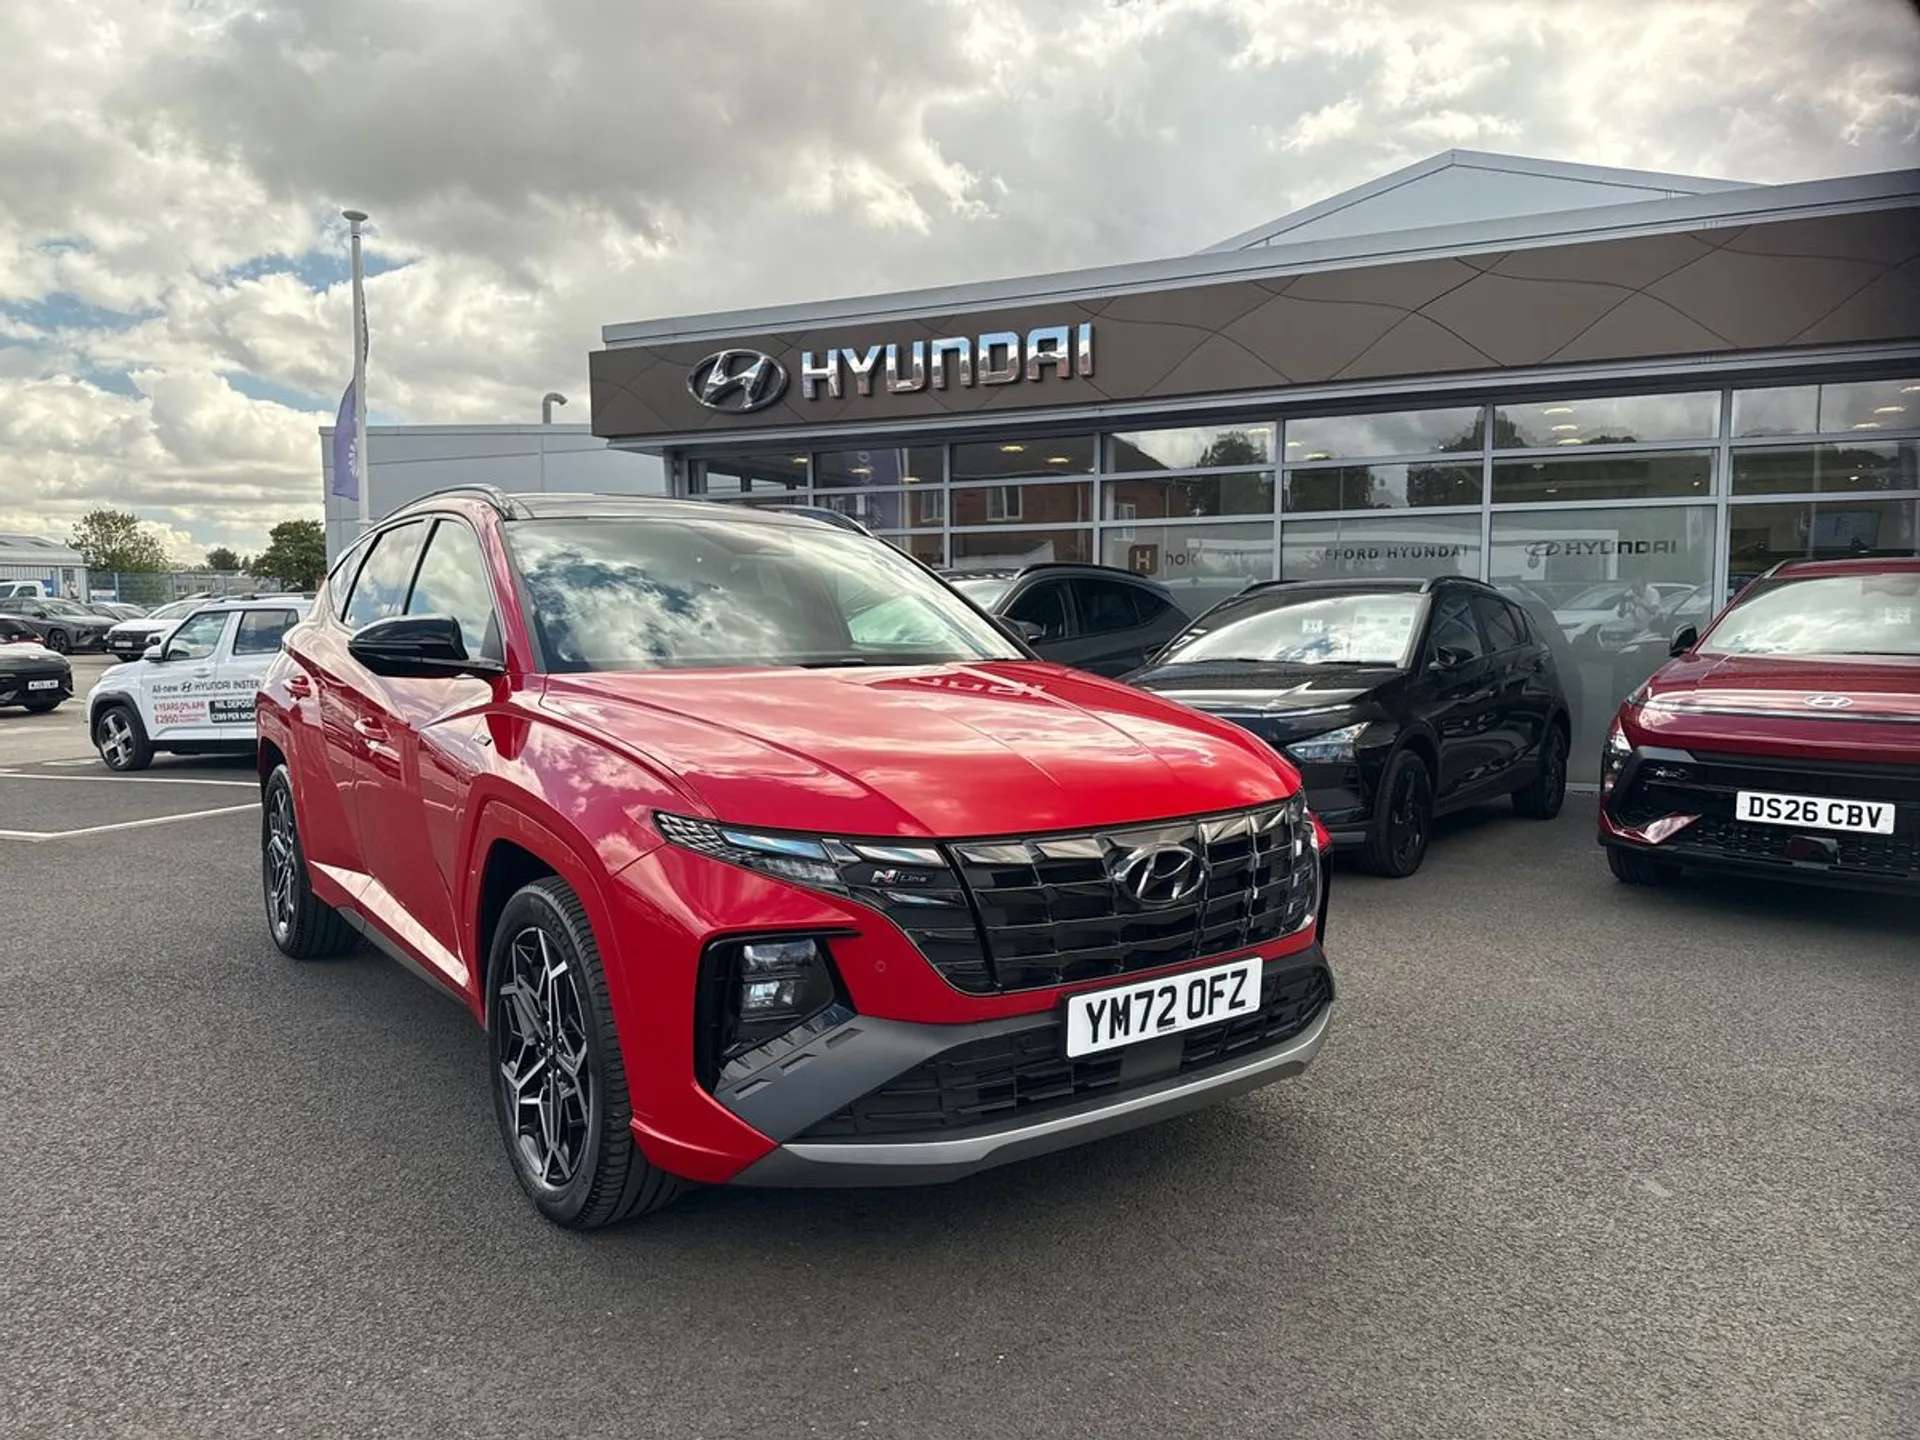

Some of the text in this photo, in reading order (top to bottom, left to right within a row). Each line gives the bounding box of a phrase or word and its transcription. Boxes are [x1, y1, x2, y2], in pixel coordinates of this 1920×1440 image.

[801, 321, 1094, 399] HYUNDAI
[1387, 544, 1467, 558] HYUNDAI
[1565, 540, 1676, 555] HYUNDAI
[194, 680, 232, 691] HYUNDAI
[232, 679, 260, 689] INSTER
[1748, 796, 1883, 828] DS26 CBV
[1085, 968, 1248, 1044] YM72 OFZ
